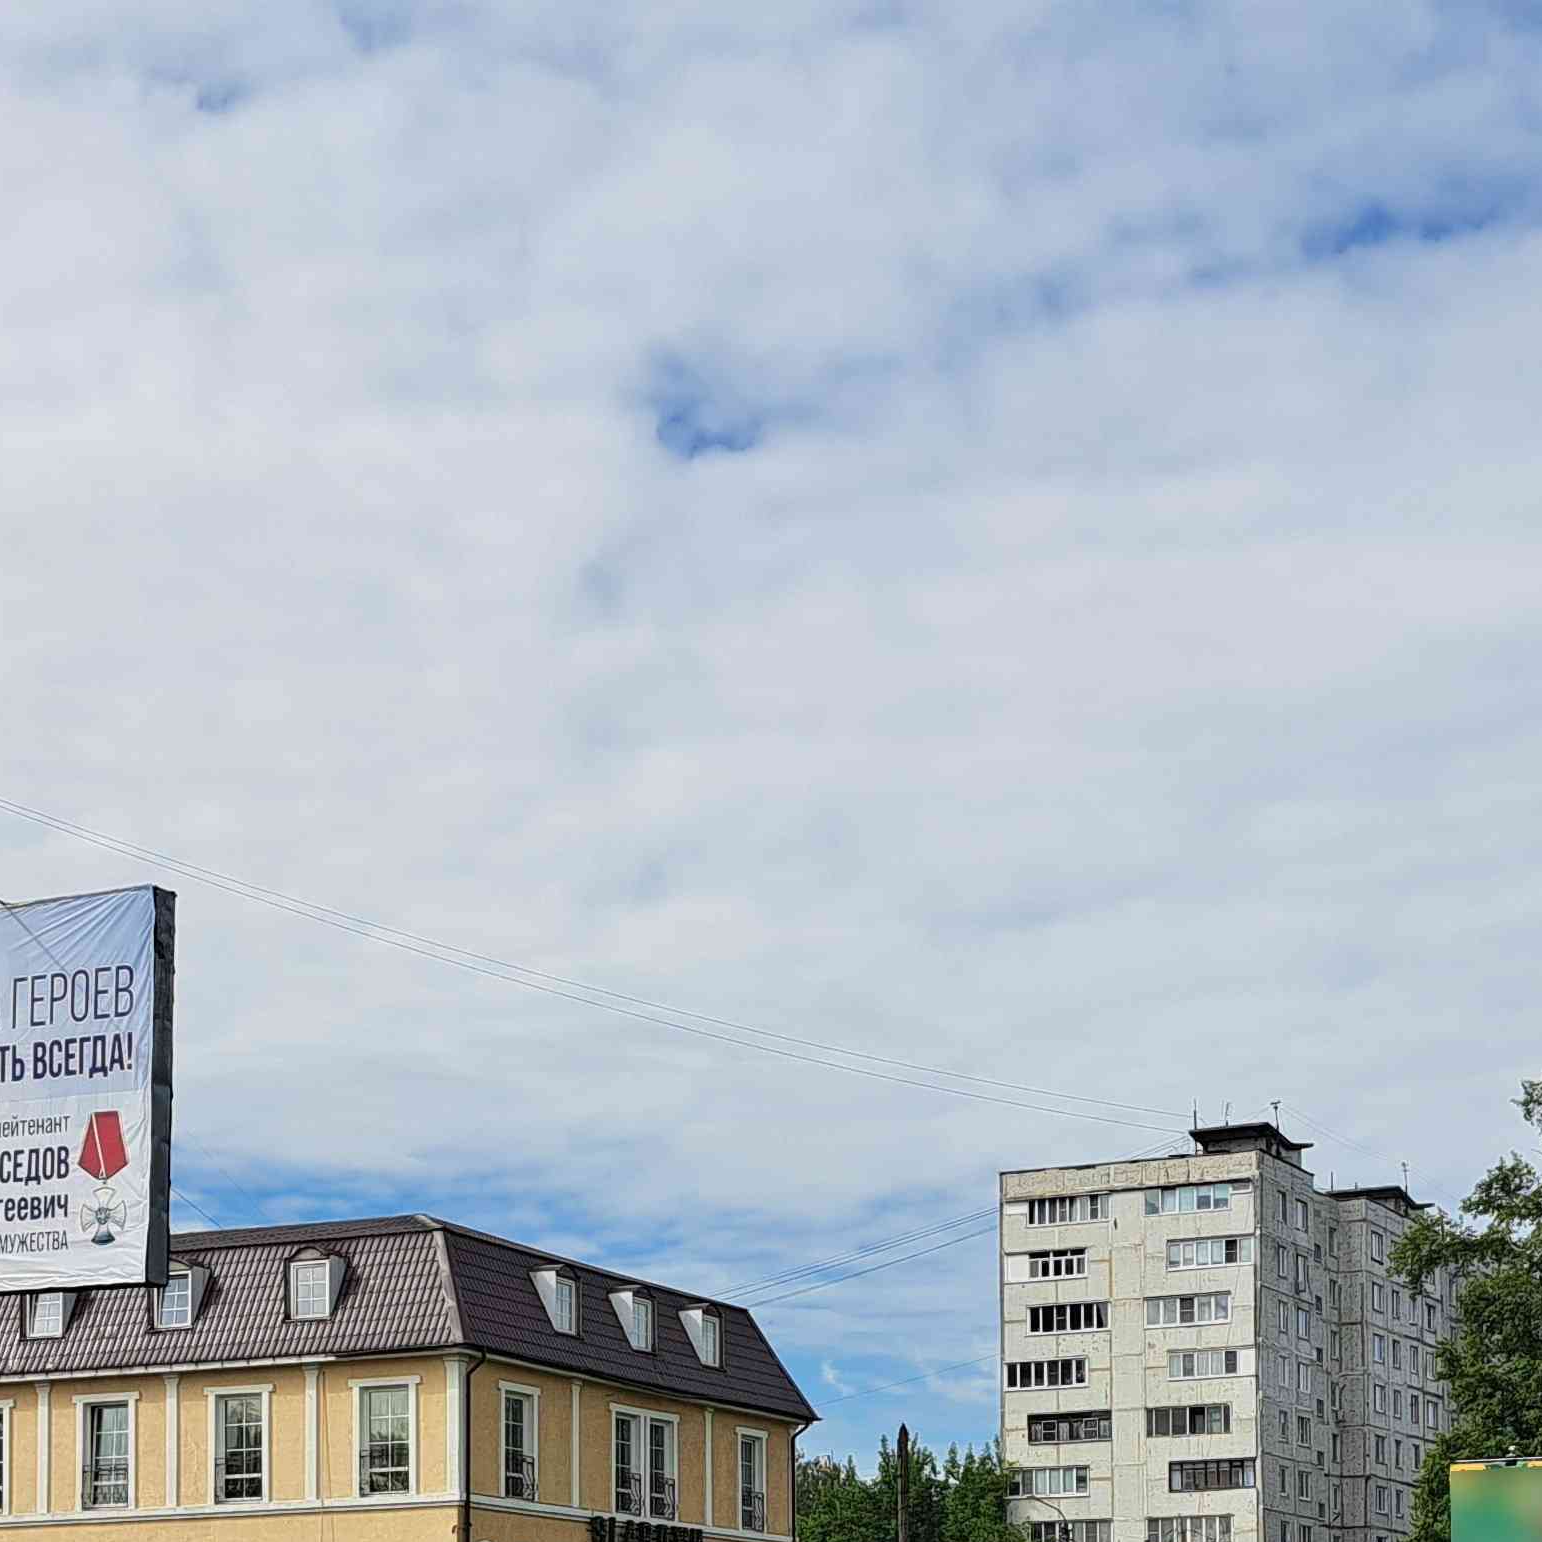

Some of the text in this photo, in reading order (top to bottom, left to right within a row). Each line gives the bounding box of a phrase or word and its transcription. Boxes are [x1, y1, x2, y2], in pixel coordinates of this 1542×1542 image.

[11, 965, 135, 1030] ГЕРОЕВ
[32, 1033, 133, 1079] ВСЕГДА!
[0, 1145, 70, 1186] СЕДОВ
